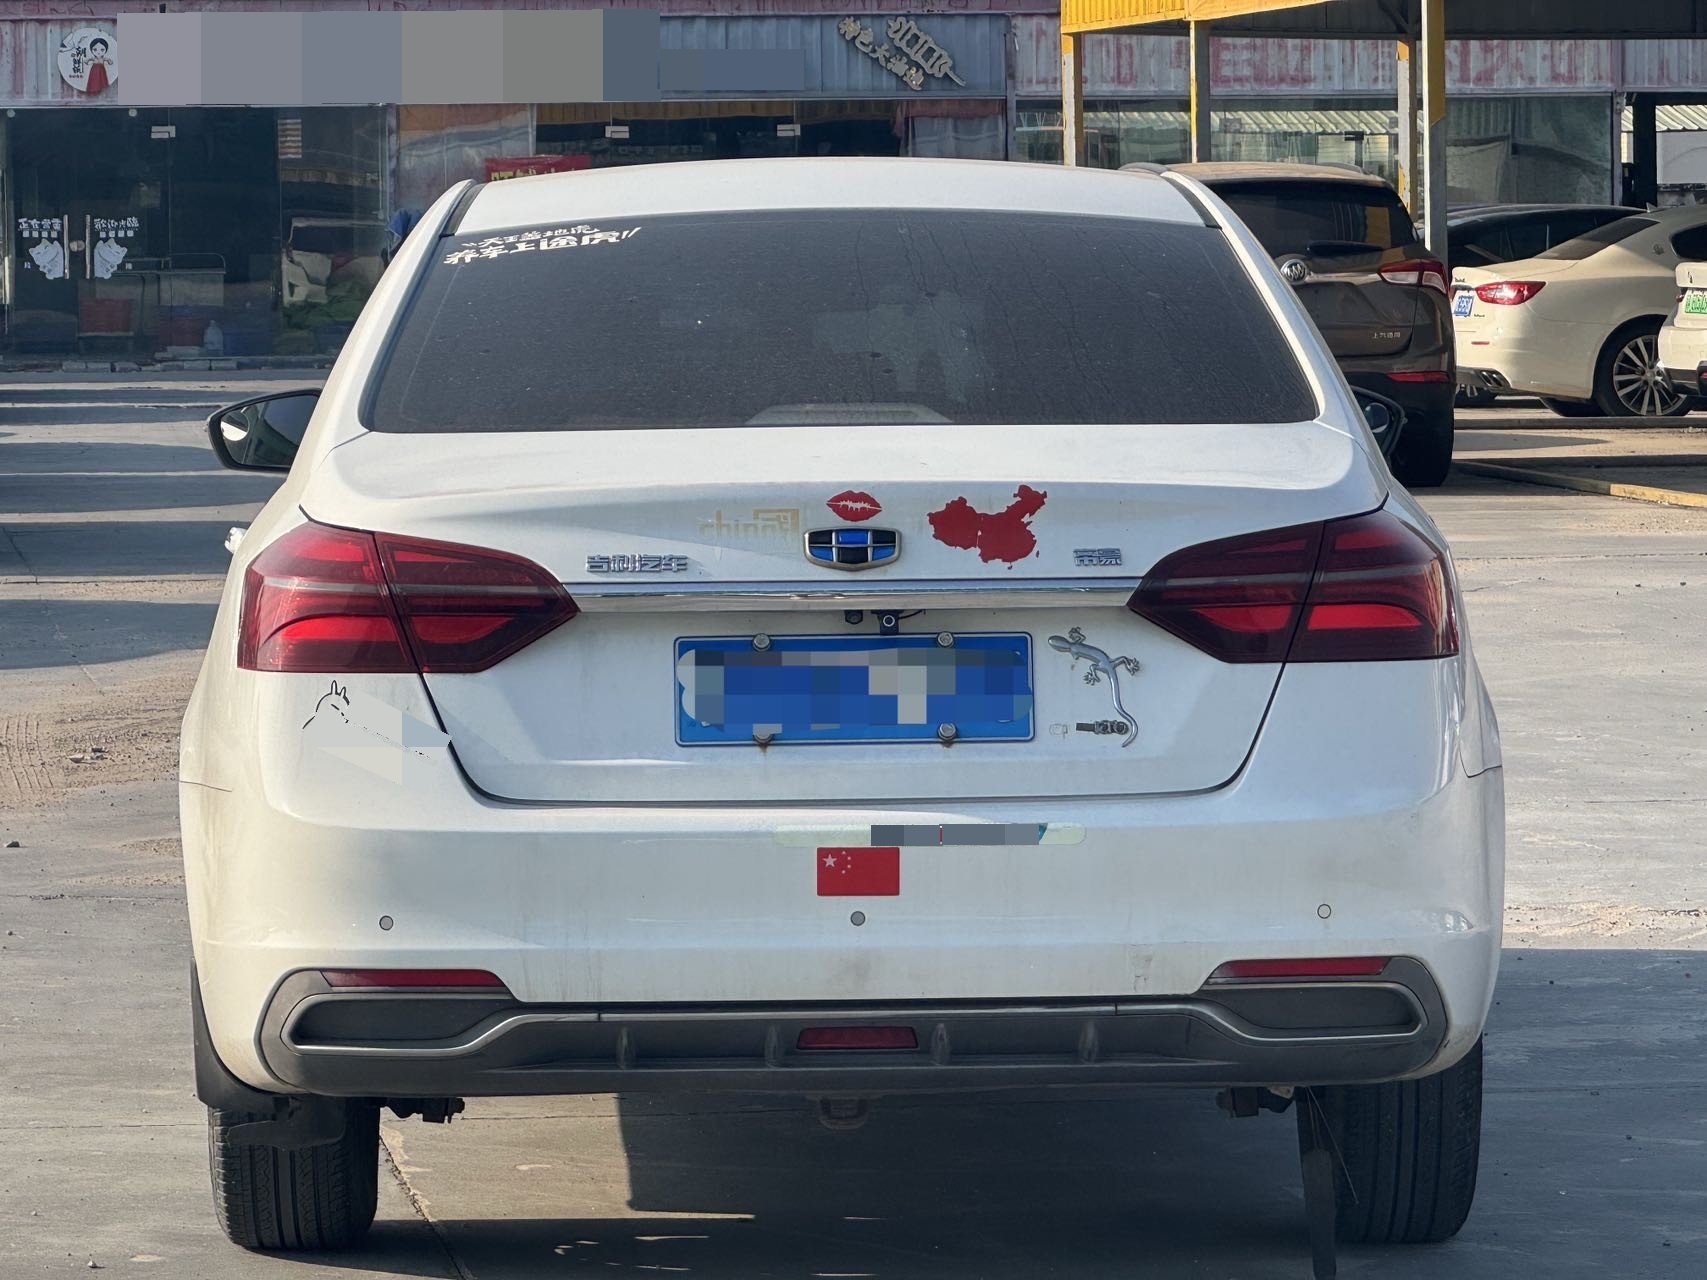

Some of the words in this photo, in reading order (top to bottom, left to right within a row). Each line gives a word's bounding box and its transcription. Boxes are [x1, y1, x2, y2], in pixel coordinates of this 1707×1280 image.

[585, 553, 689, 573] 吉利汽车
[1073, 547, 1122, 567] 帝豪
